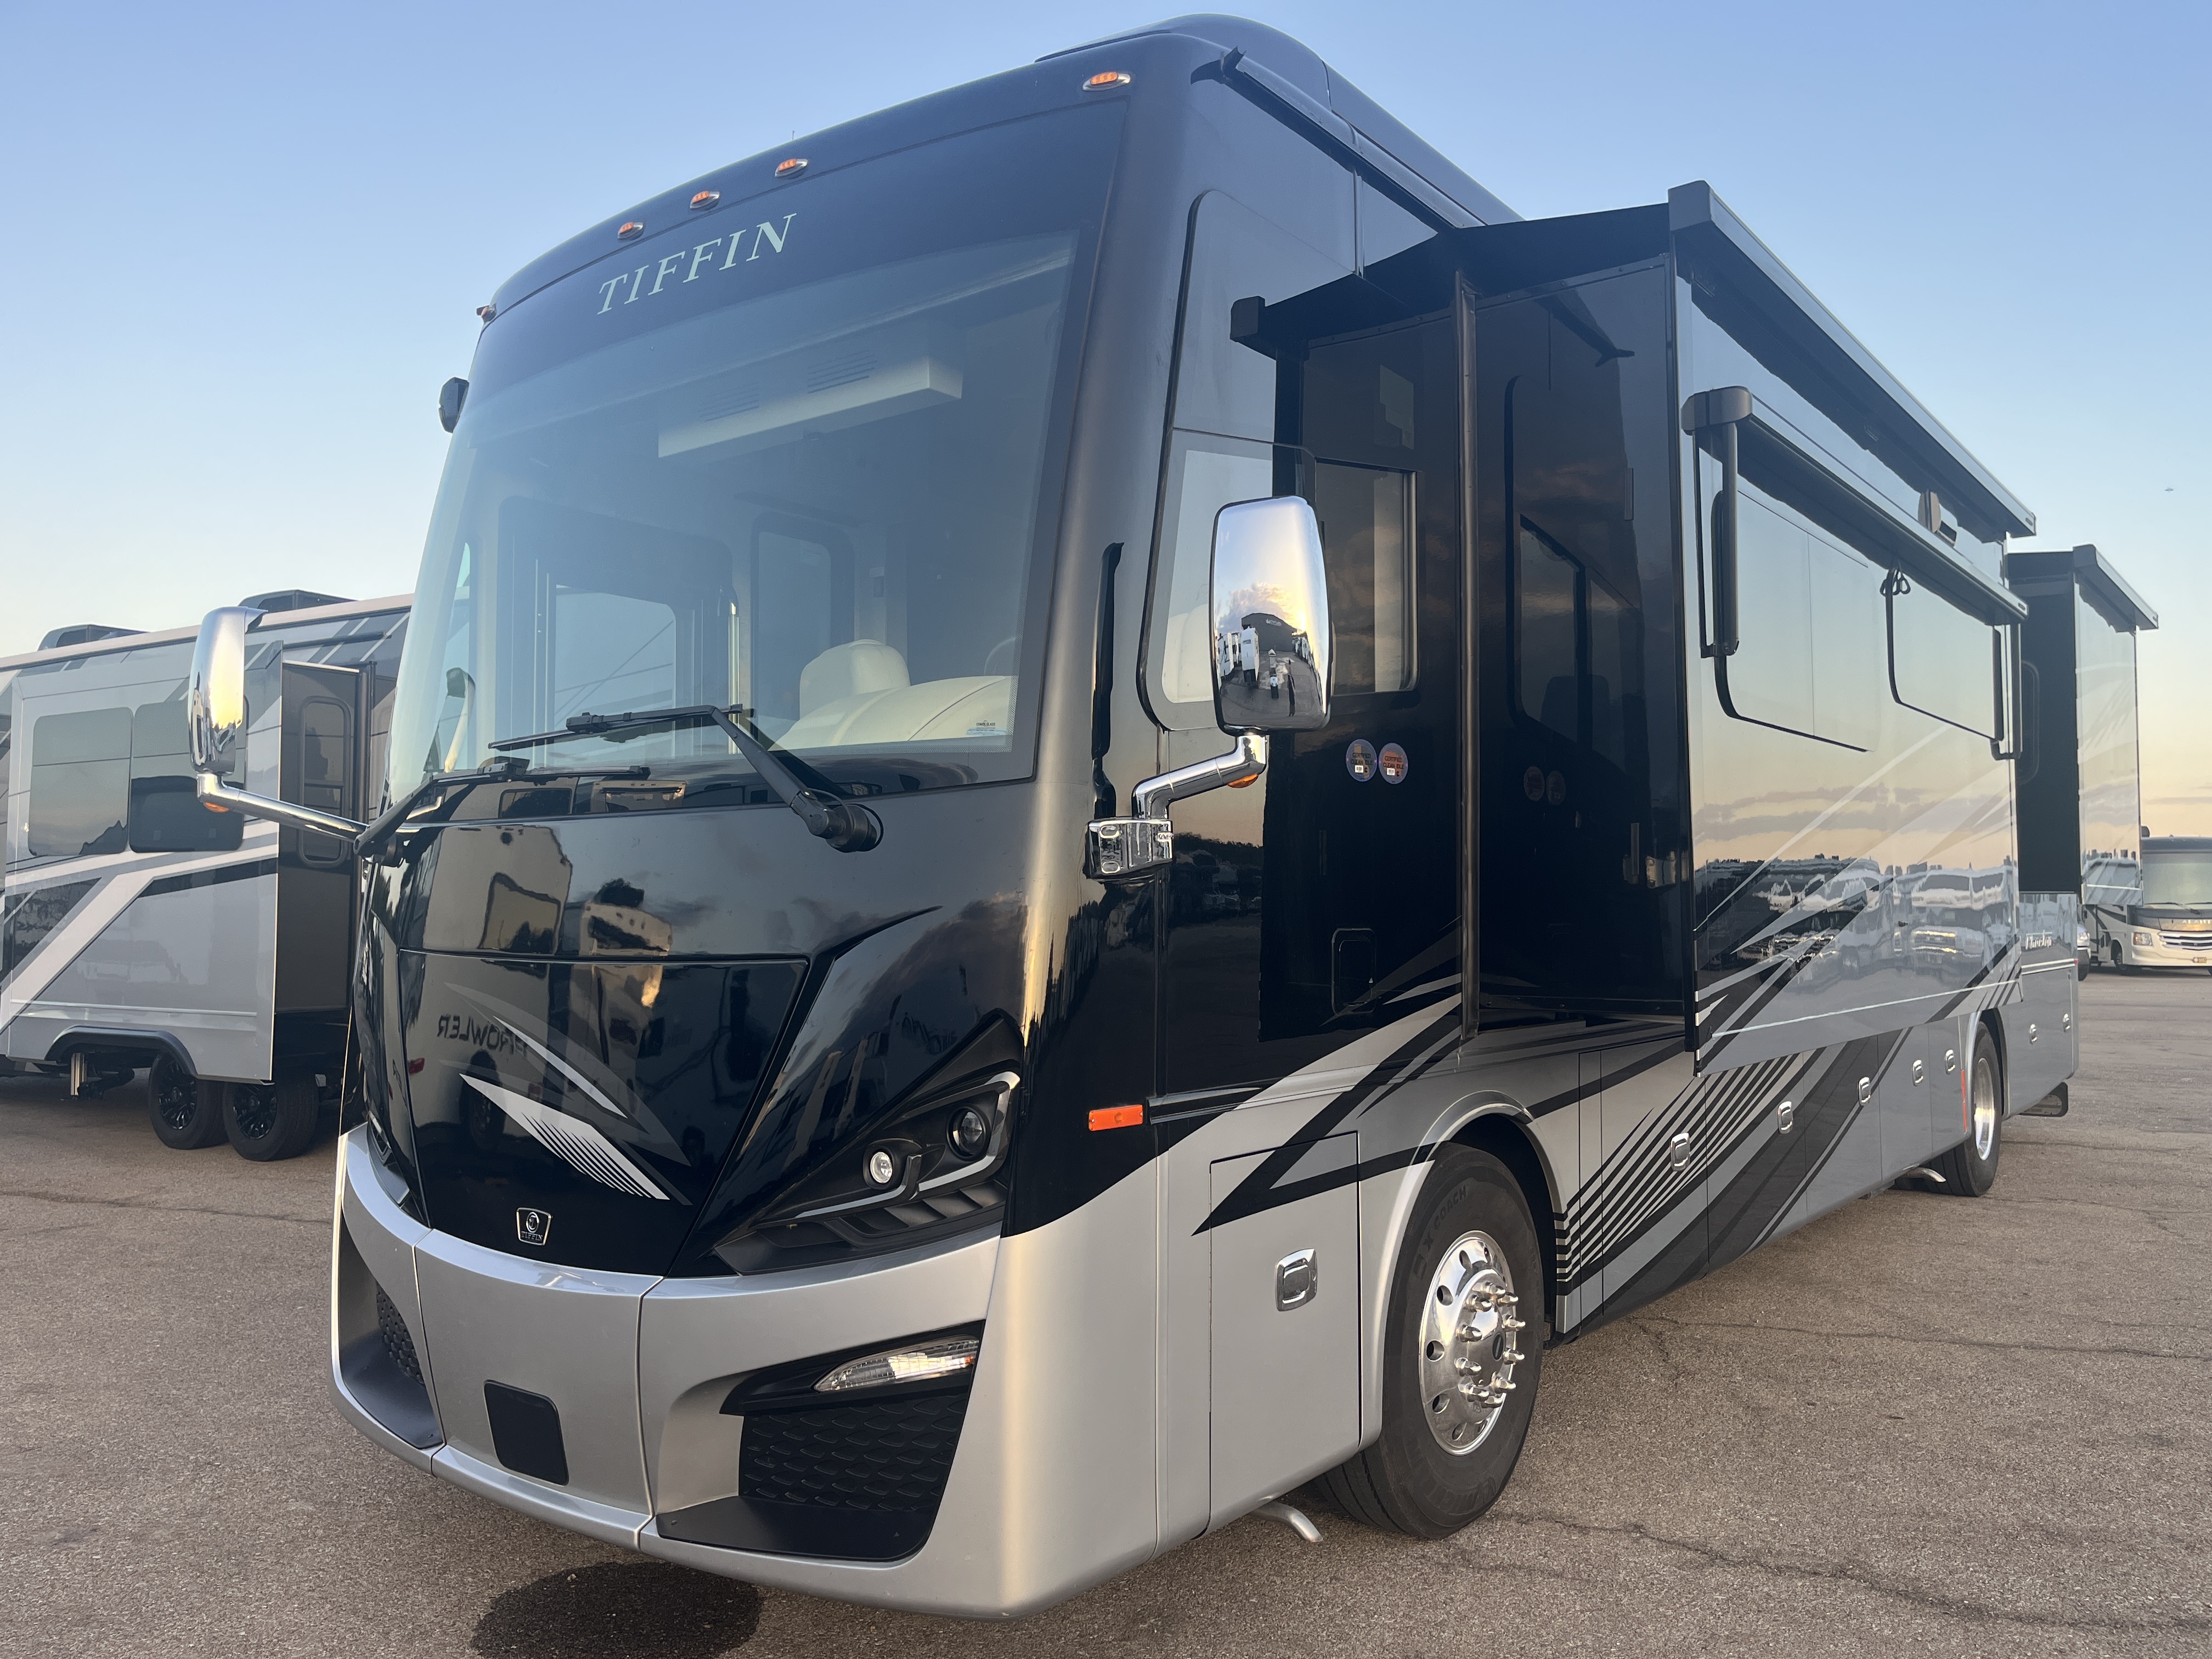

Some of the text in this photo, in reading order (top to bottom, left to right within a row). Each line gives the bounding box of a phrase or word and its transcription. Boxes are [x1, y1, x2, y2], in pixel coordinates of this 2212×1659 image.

[597, 212, 797, 315] TIFFIN
[1434, 1185, 1467, 1230] COACH
[521, 1231, 543, 1242] TIFFIN
